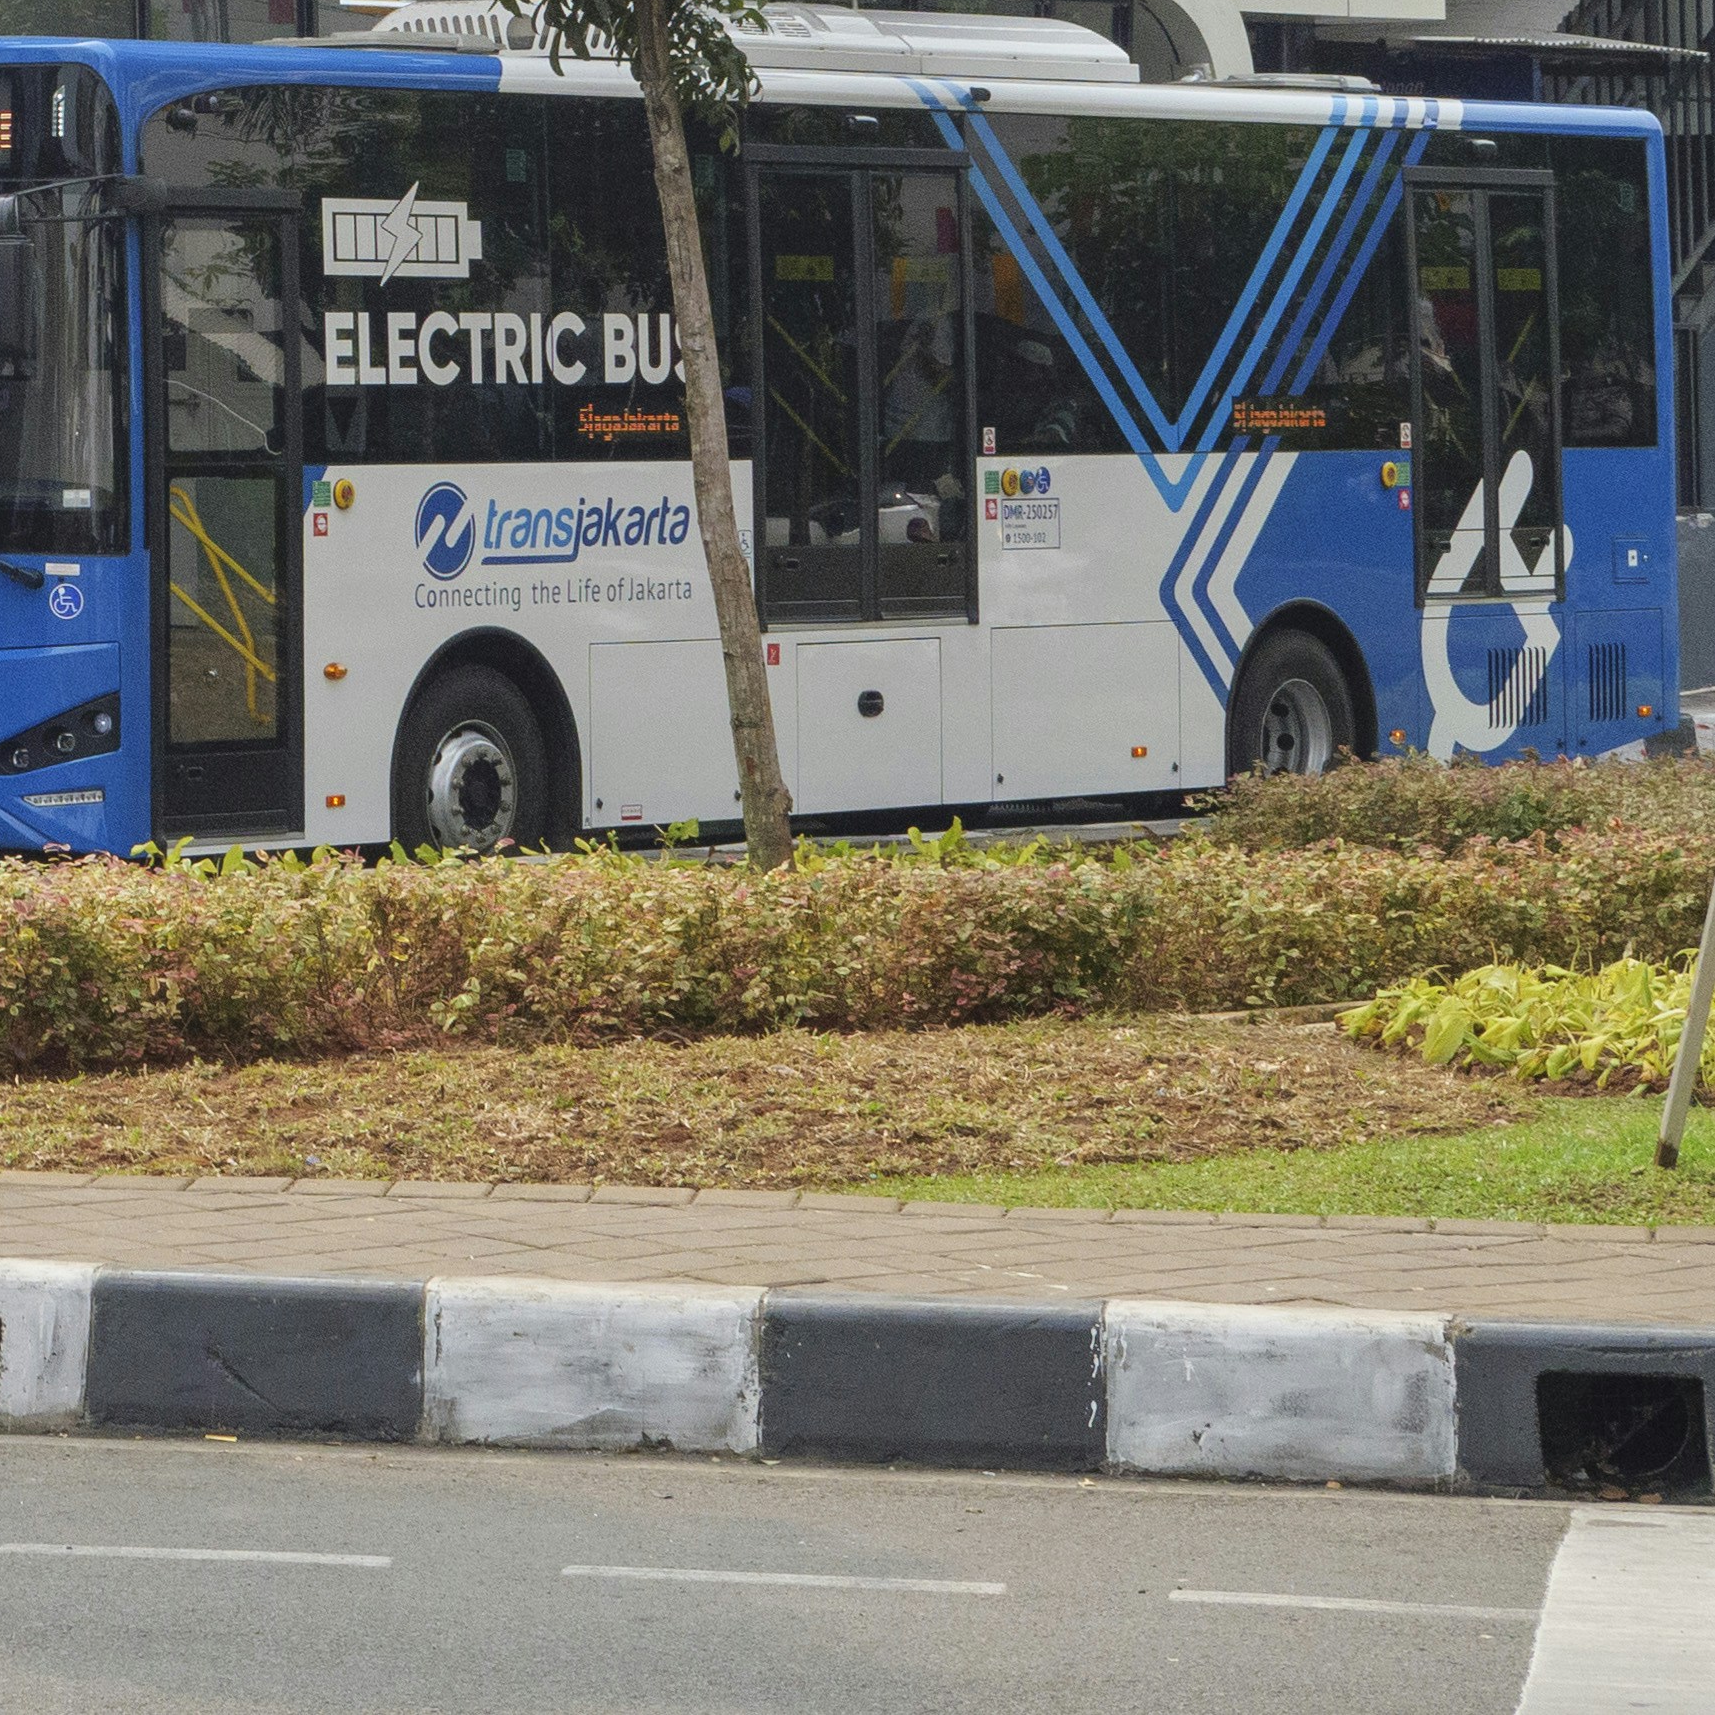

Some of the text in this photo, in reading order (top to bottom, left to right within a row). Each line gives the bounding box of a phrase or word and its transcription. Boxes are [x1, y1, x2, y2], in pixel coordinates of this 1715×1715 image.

[324, 310, 686, 385] ELECTRIC BU
[481, 495, 690, 566] transjakarta
[414, 577, 693, 612] Connecting the Life of Jakarta
